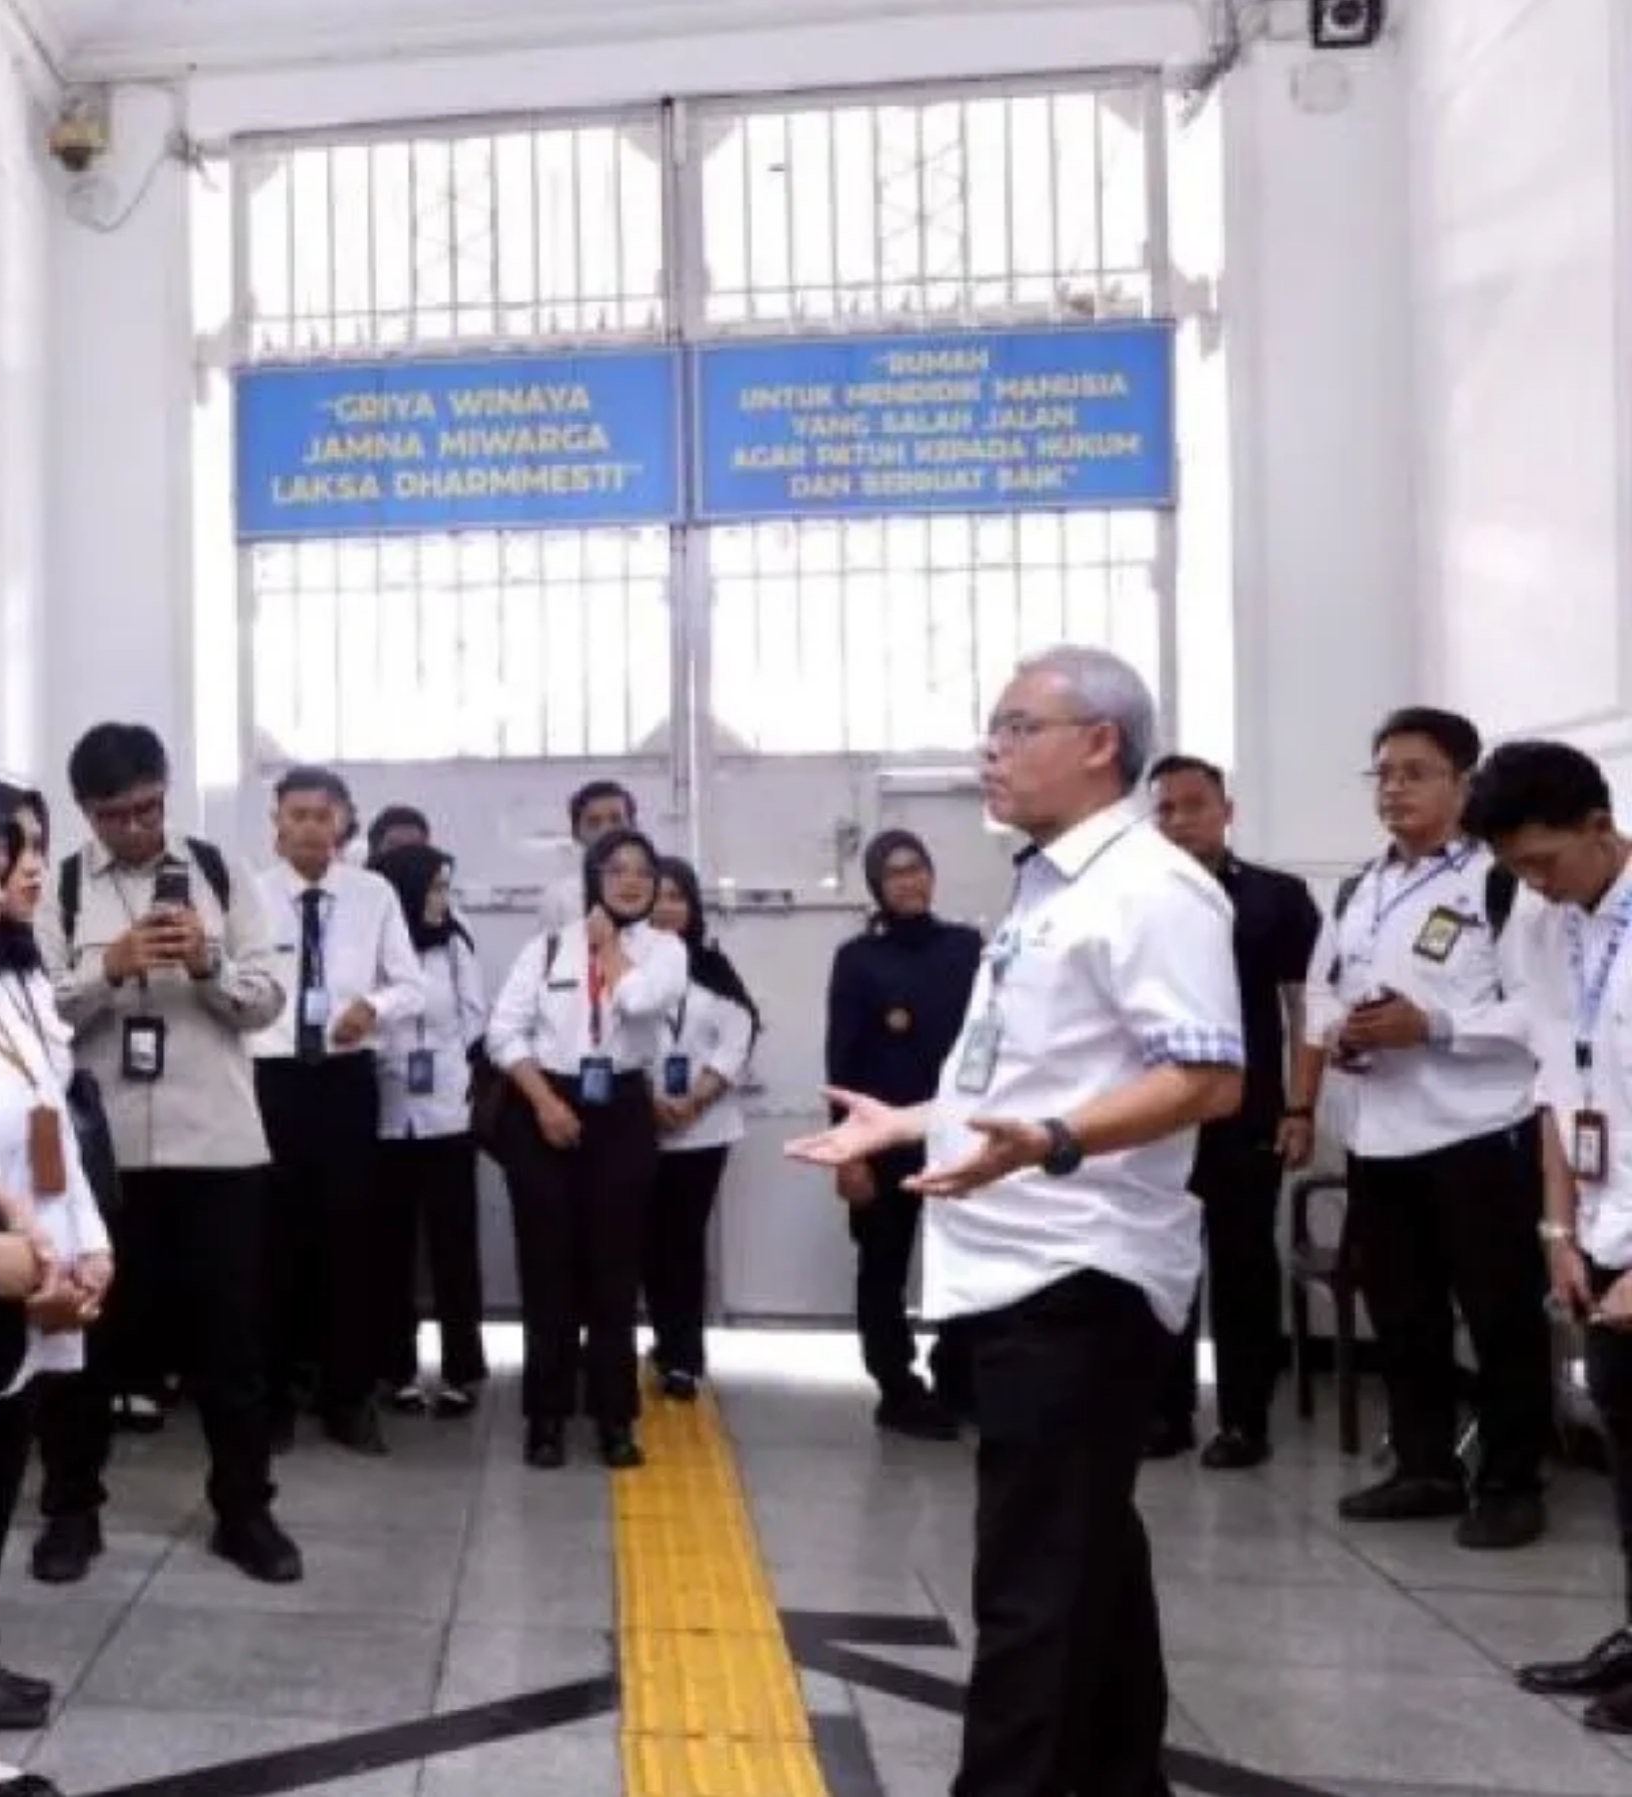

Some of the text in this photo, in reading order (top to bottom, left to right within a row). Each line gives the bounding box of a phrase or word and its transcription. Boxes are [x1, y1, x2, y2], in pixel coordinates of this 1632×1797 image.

[448, 386, 590, 417] WINAYA
[740, 385, 835, 411] UNTUK
[994, 373, 1127, 399] MANUSIA
[791, 404, 1077, 439] YANG SALAH JALAN
[439, 422, 610, 457] MIWARGA
[733, 431, 1142, 468] AGAR PATUH KEPADA HUKUM
[271, 471, 381, 505] LAKSA
[789, 472, 851, 498] DAN
[861, 468, 984, 494] BERBUAT
